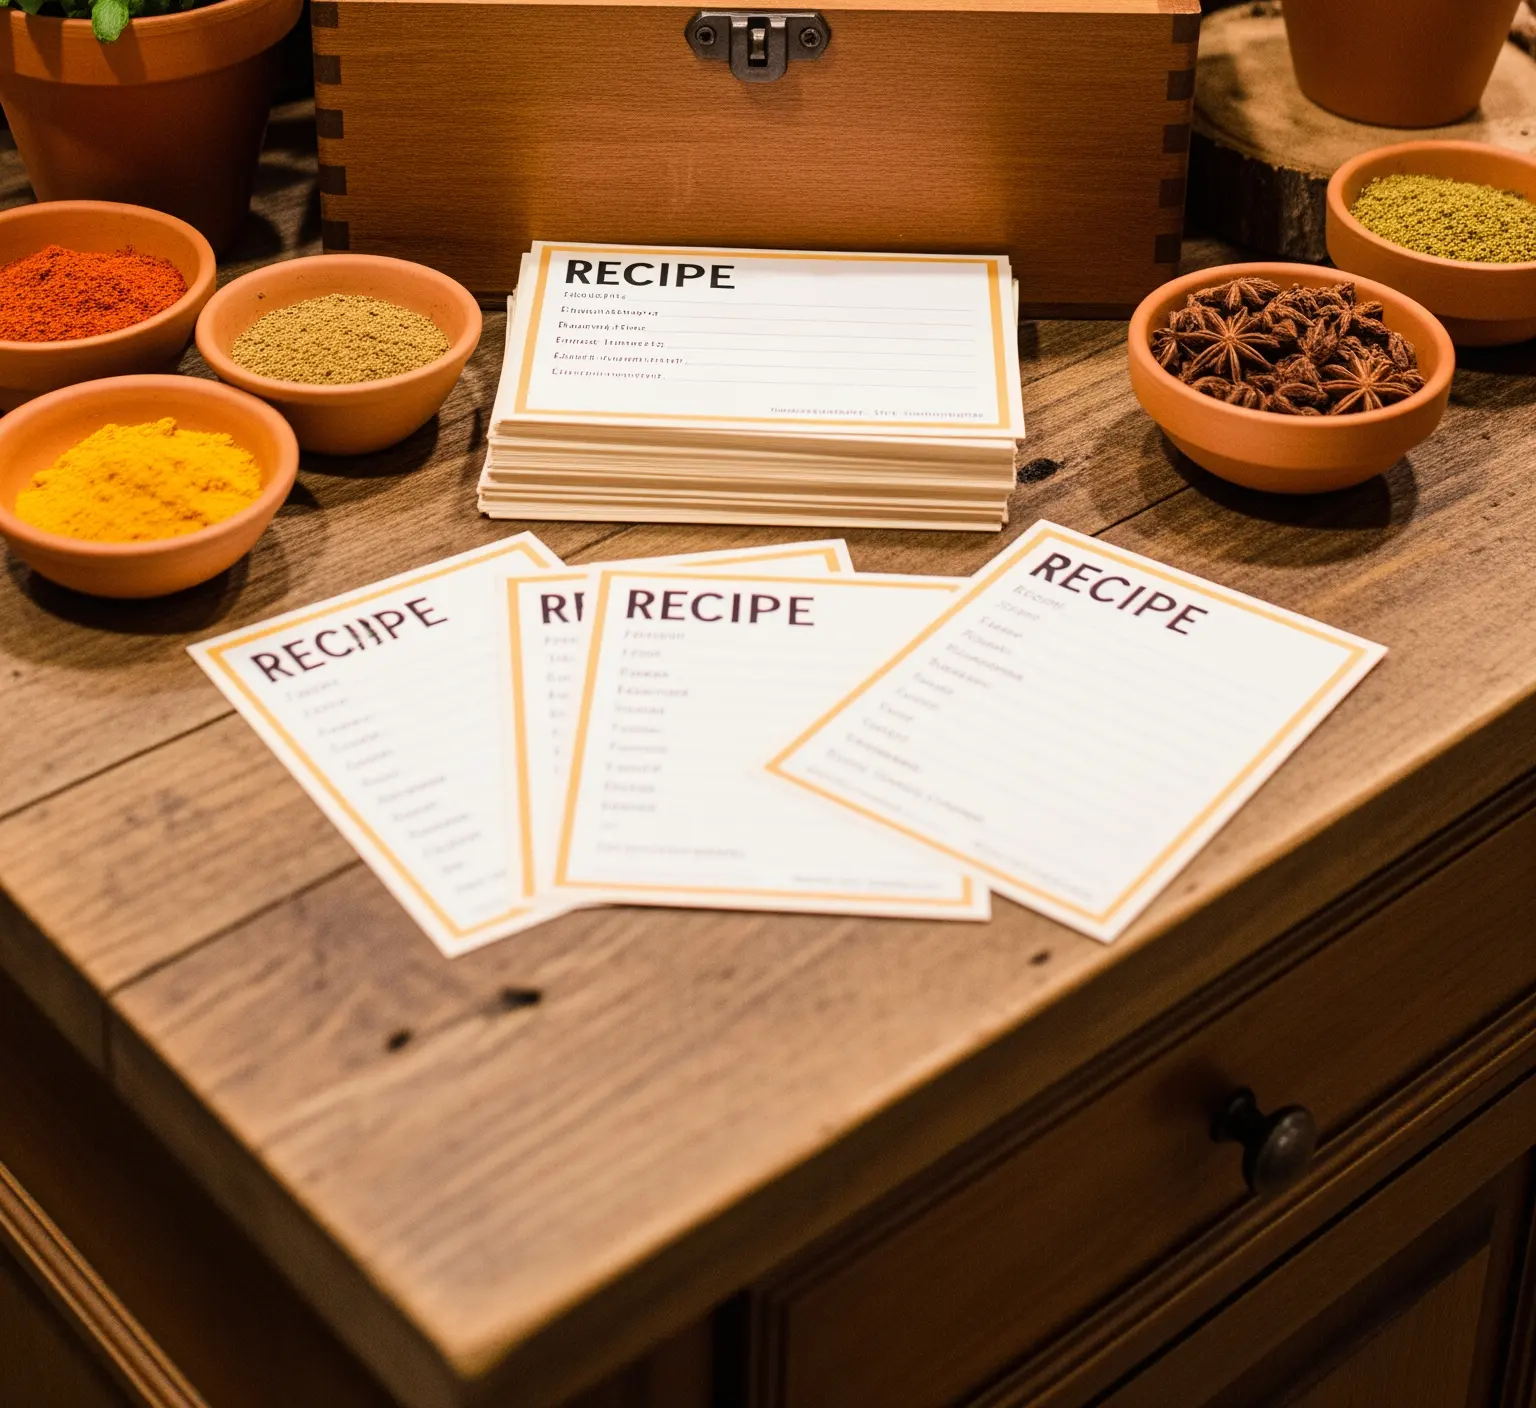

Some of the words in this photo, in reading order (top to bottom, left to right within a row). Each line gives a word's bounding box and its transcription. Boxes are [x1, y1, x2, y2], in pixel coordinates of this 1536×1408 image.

[565, 259, 735, 290] RECIPE
[625, 589, 815, 626] RECIPE
[1029, 552, 1209, 635] RECIPE
